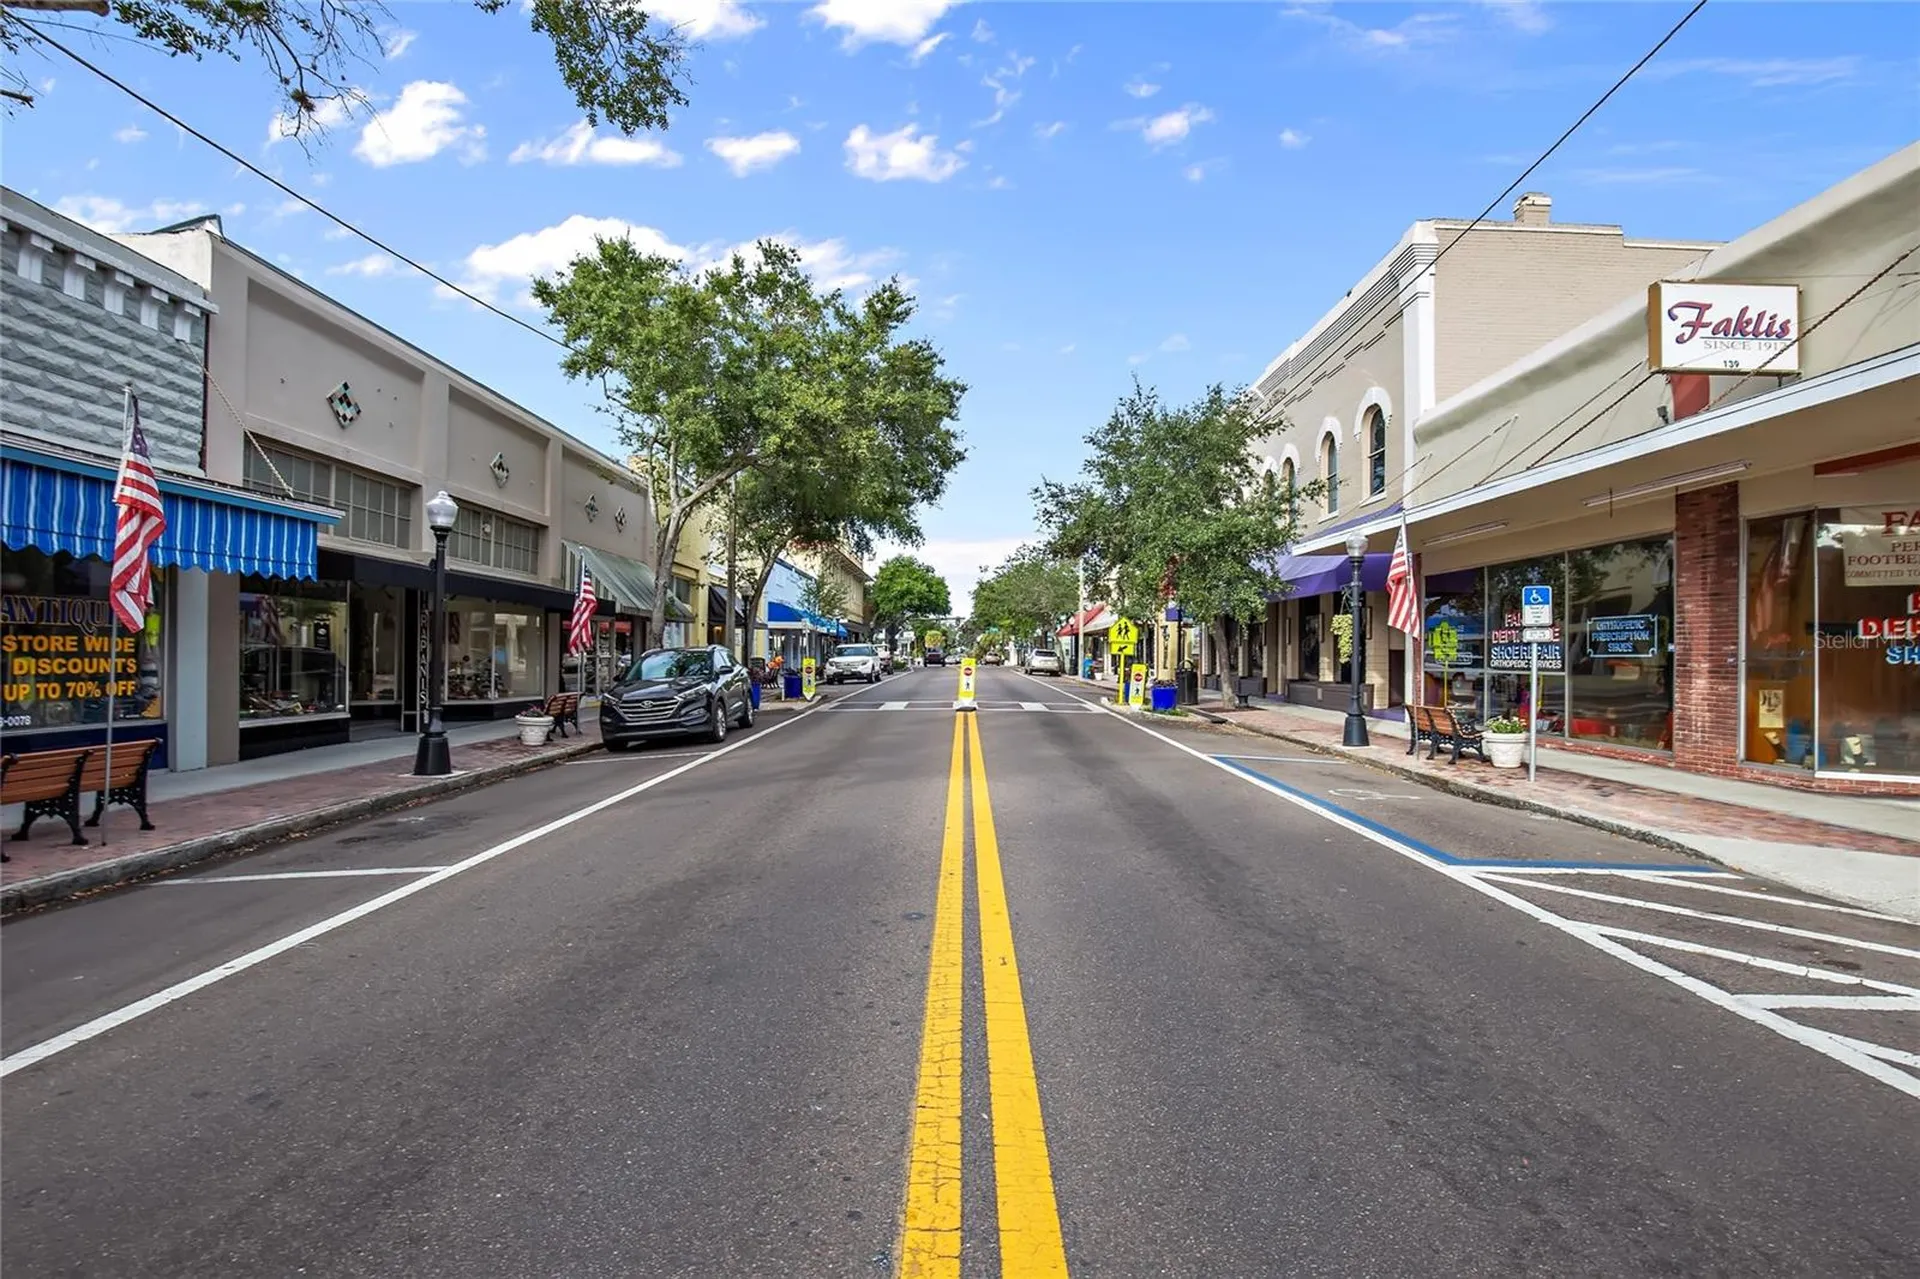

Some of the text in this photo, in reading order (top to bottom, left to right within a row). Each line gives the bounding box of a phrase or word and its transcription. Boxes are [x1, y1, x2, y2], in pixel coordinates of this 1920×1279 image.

[1667, 301, 1792, 344] Faklis
[1703, 340, 1750, 350] SINCE
[1723, 360, 1740, 368] 139
[1847, 554, 1920, 566] FOOTBE
[2, 634, 136, 652] STORE WIDE
[1491, 644, 1520, 659] SHOE
[12, 657, 137, 675] DISCOUNTS
[1490, 659, 1562, 669] ORTHOPEDIC SRVICES
[3, 680, 136, 702] UP TO 70% OFF
